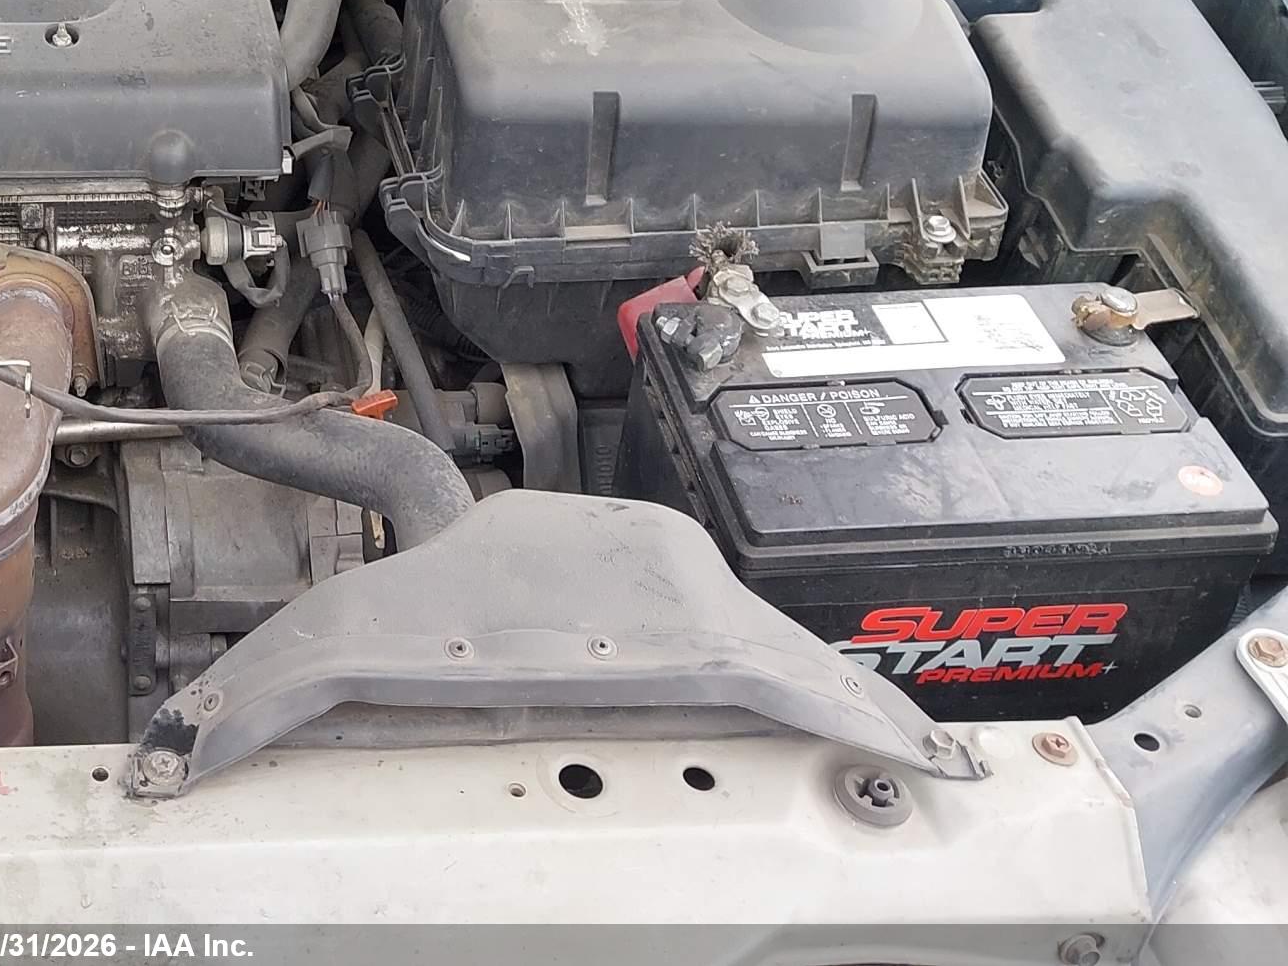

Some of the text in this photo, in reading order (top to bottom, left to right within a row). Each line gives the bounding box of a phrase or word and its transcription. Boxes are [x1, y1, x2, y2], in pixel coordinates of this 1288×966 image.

[762, 391, 818, 403] DANGER
[831, 389, 881, 400] POISON
[850, 603, 1128, 644] SUPER
